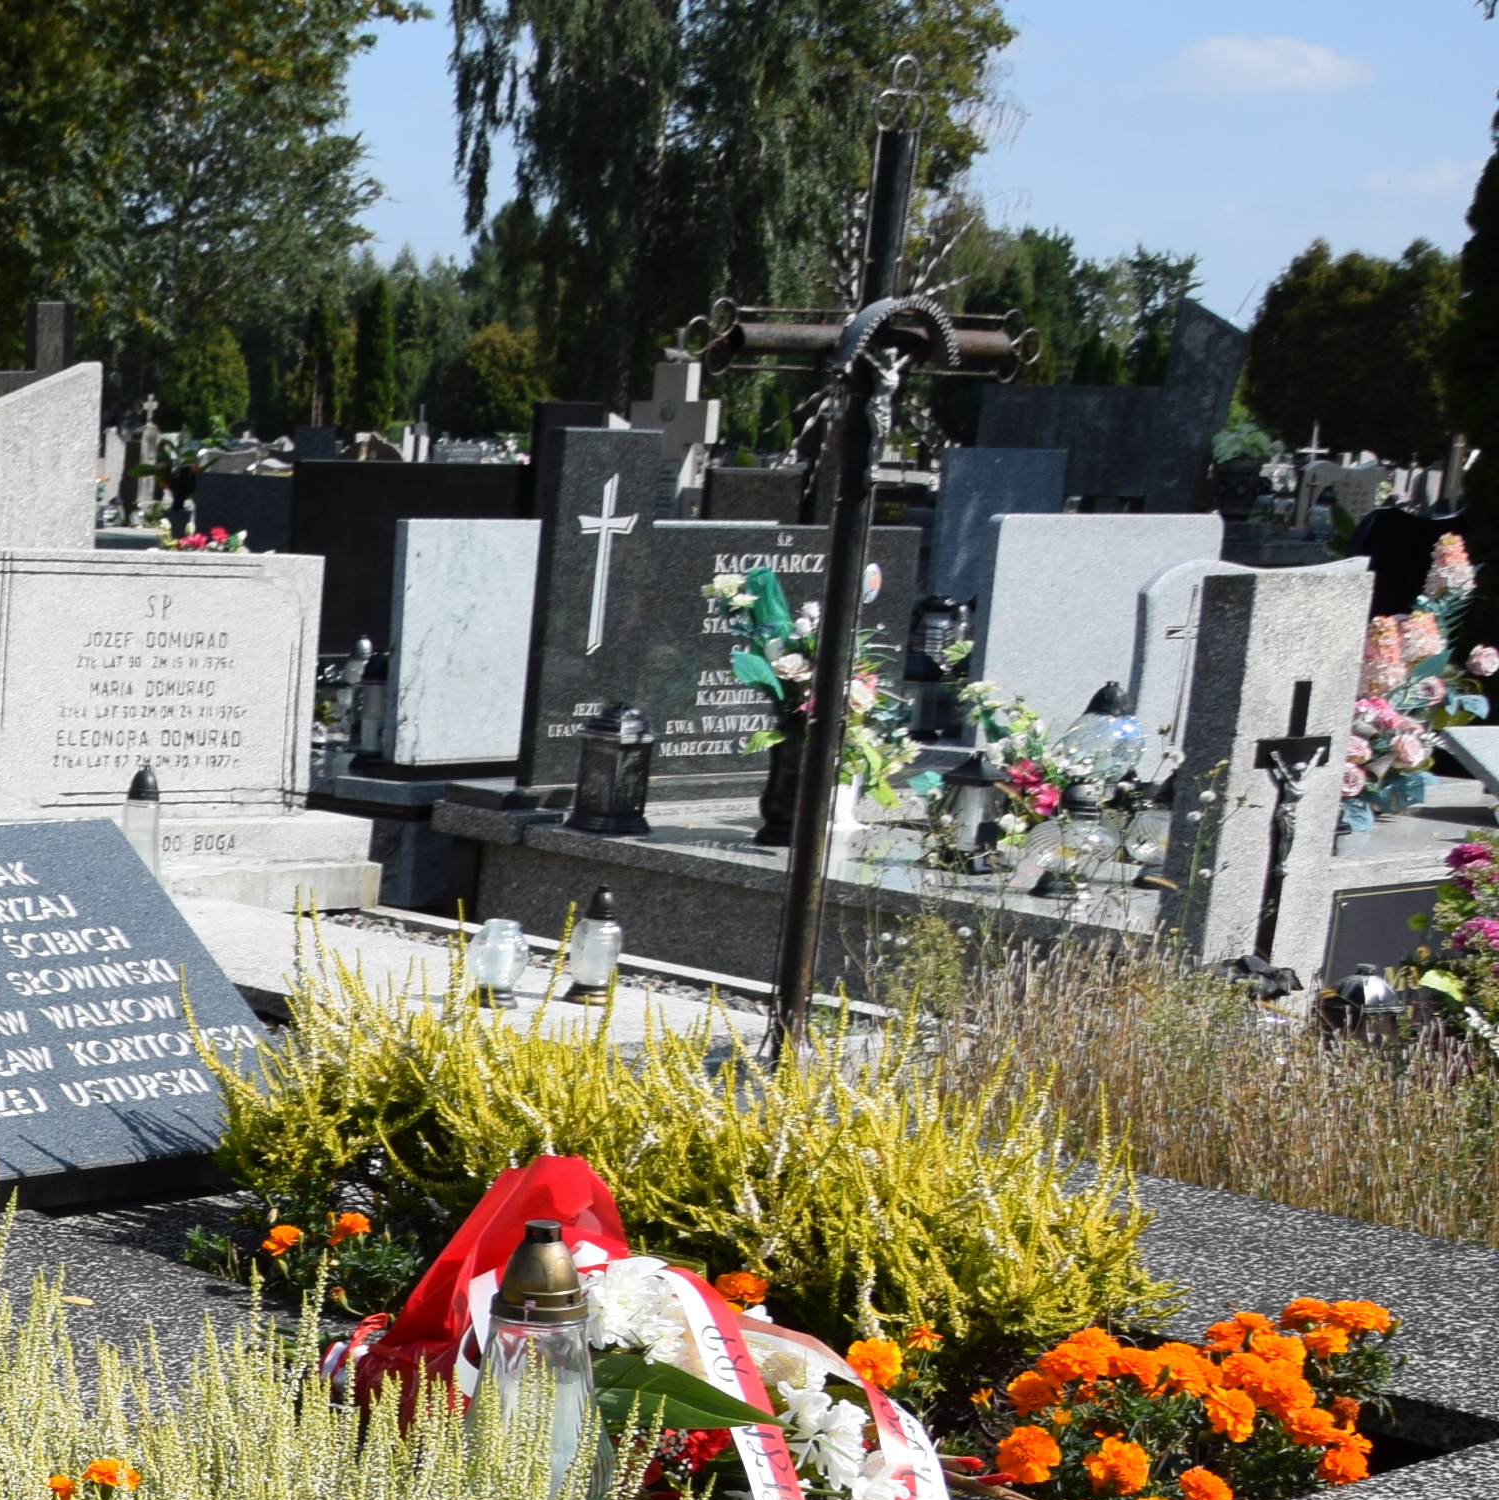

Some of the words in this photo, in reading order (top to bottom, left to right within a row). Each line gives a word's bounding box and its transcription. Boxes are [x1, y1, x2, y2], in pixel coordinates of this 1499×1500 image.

[145, 631, 229, 649] DOMURAD
[90, 680, 133, 697] MARIA
[145, 680, 215, 697] DOMURAD
[665, 720, 695, 734] EWA
[56, 729, 149, 749] ELEONORA
[160, 729, 241, 748] DOMURAD
[658, 740, 734, 757] MARECZEK
[193, 833, 235, 852] BOGA
[1, 926, 131, 960] ŚCIBICH
[6, 956, 180, 997] SŁOWIŃSKI
[39, 995, 178, 1030] WALKOW
[66, 1024, 258, 1067] KORYTOWSKI
[59, 1067, 210, 1108] USTUPSKI
